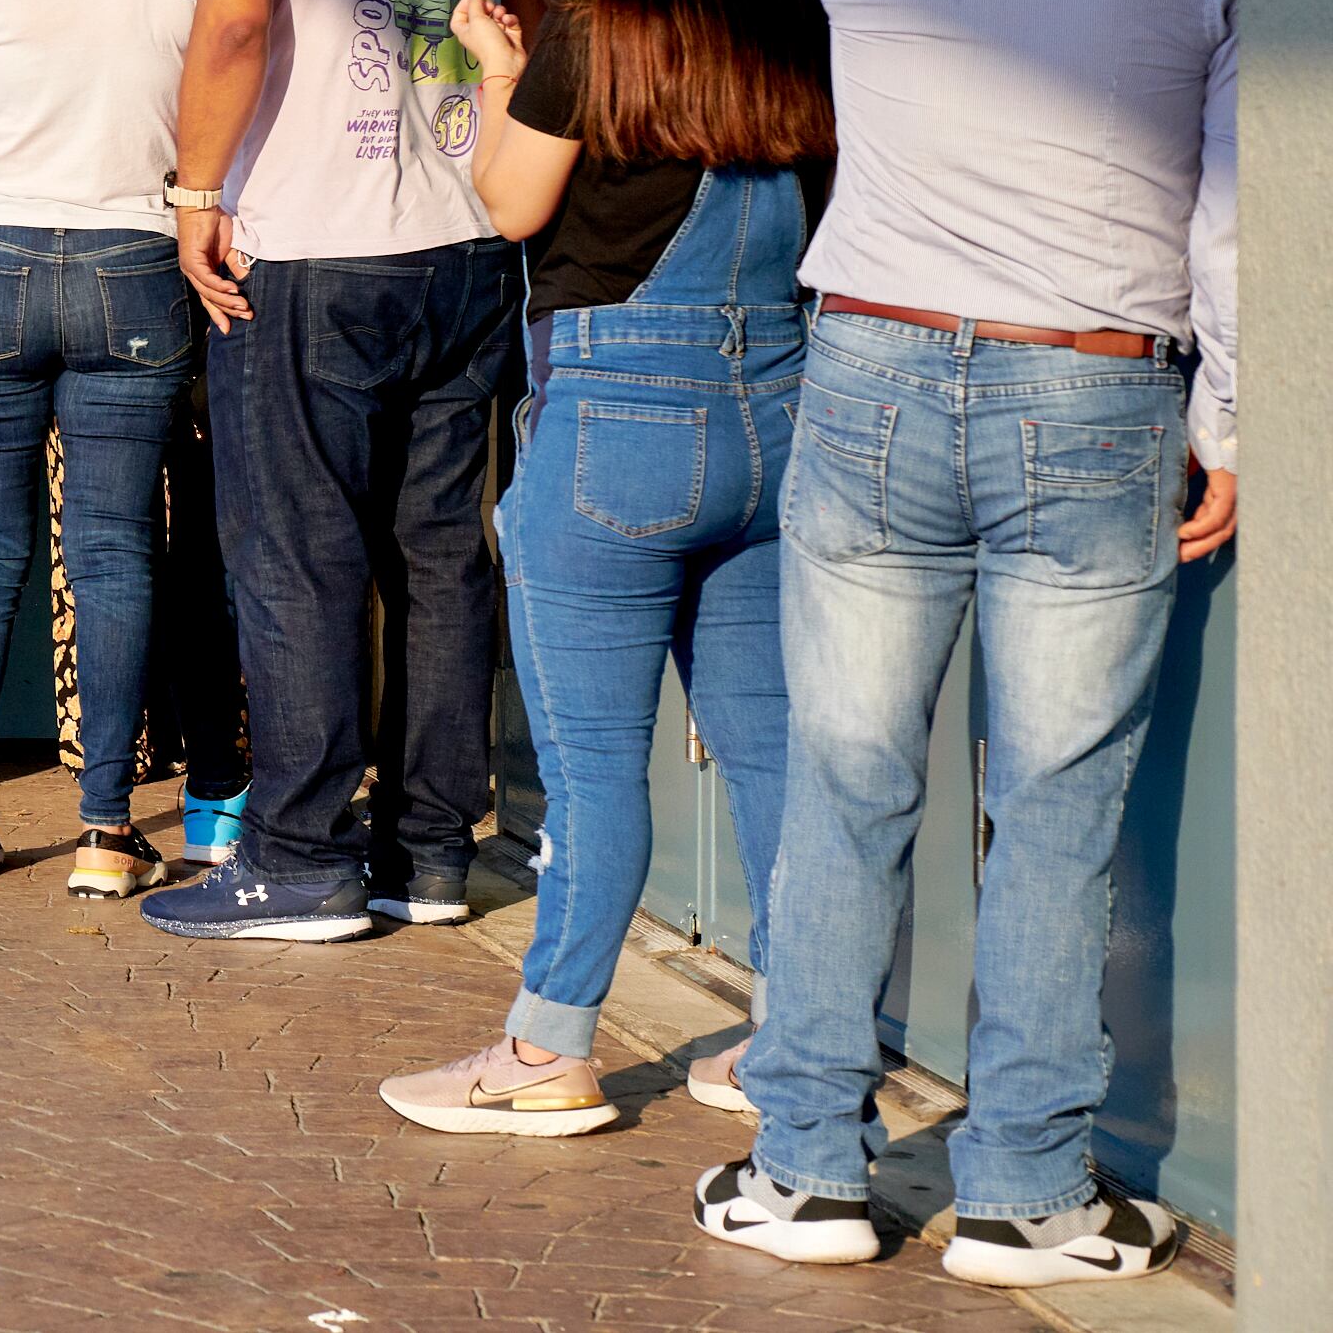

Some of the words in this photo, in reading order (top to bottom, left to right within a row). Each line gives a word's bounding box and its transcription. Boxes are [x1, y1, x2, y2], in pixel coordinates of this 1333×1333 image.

[357, 109, 382, 119] THEY
[360, 135, 375, 144] BUT
[355, 145, 399, 160] LISTEN
